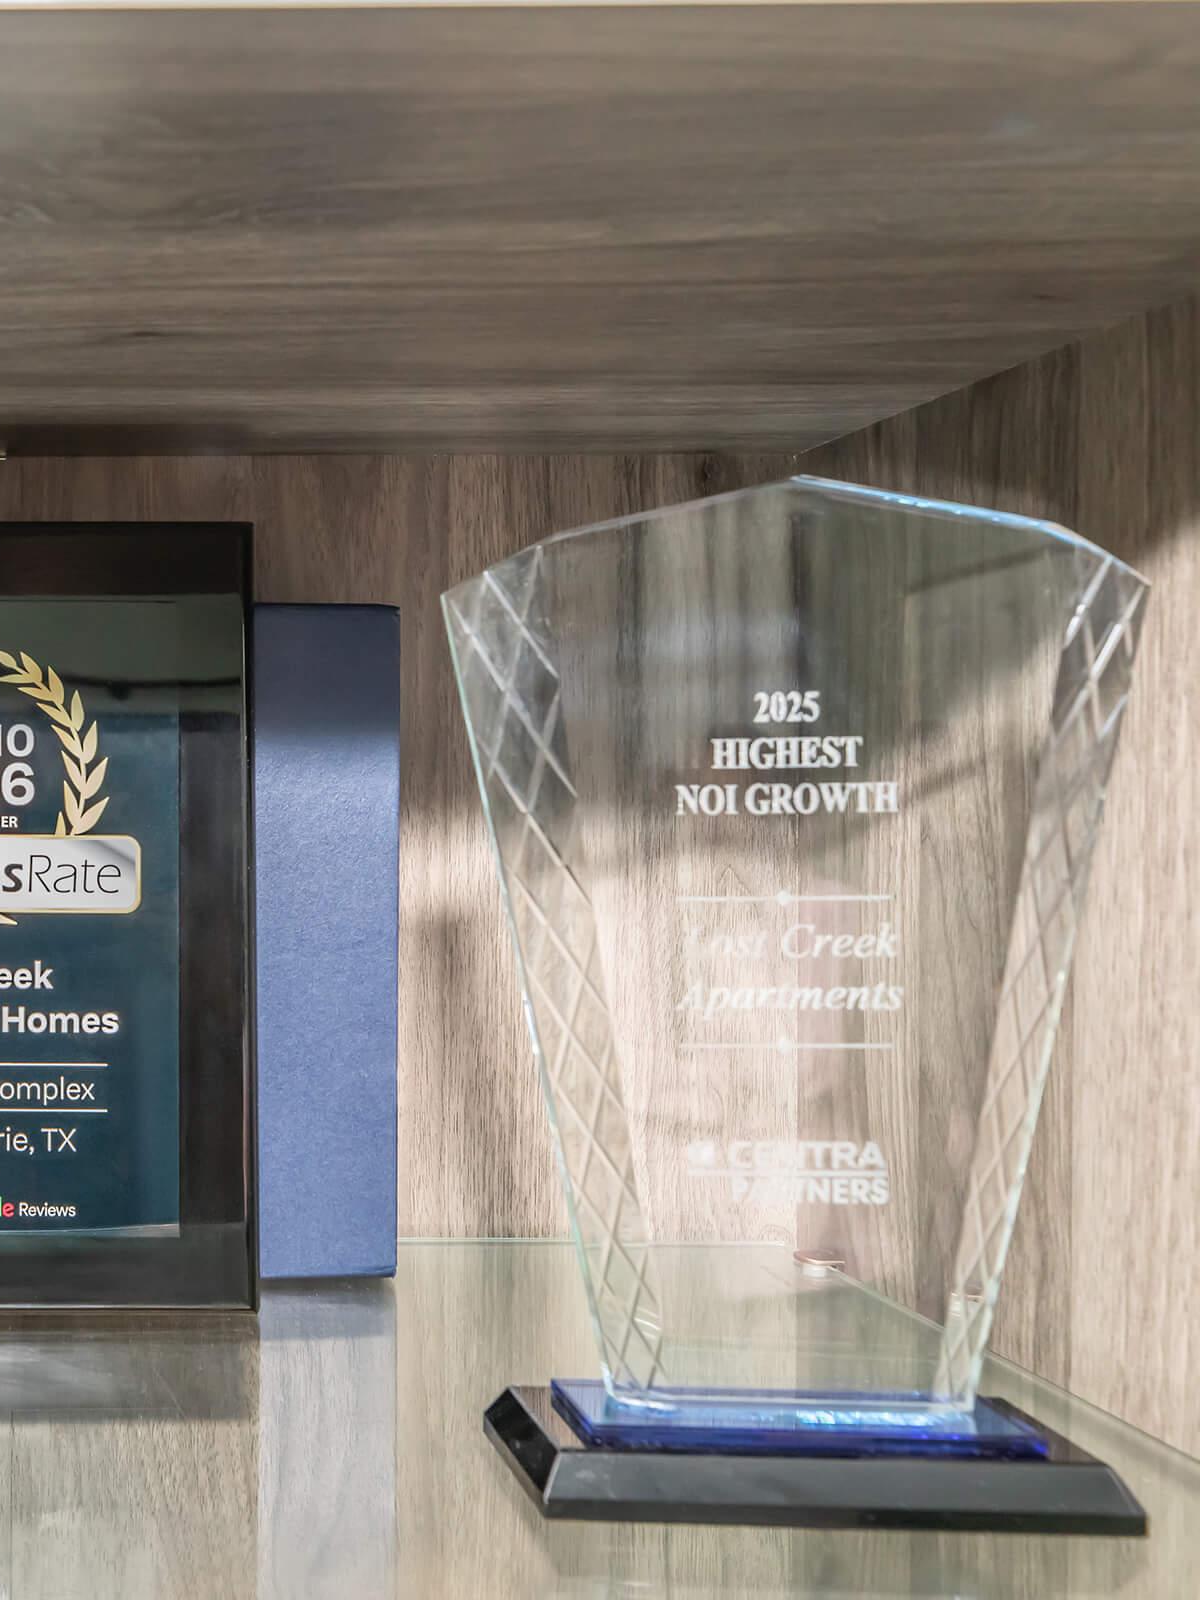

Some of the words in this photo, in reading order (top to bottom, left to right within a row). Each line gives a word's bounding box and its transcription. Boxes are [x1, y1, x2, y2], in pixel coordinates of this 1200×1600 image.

[752, 690, 821, 723] 2025
[710, 735, 864, 770] HIGHEST
[674, 782, 739, 817] NOI
[744, 780, 899, 816] GROWTH
[782, 921, 898, 960] Creek
[0, 1005, 120, 1035] Homes
[40, 1127, 78, 1153] TX
[18, 1201, 77, 1218] Reviews
